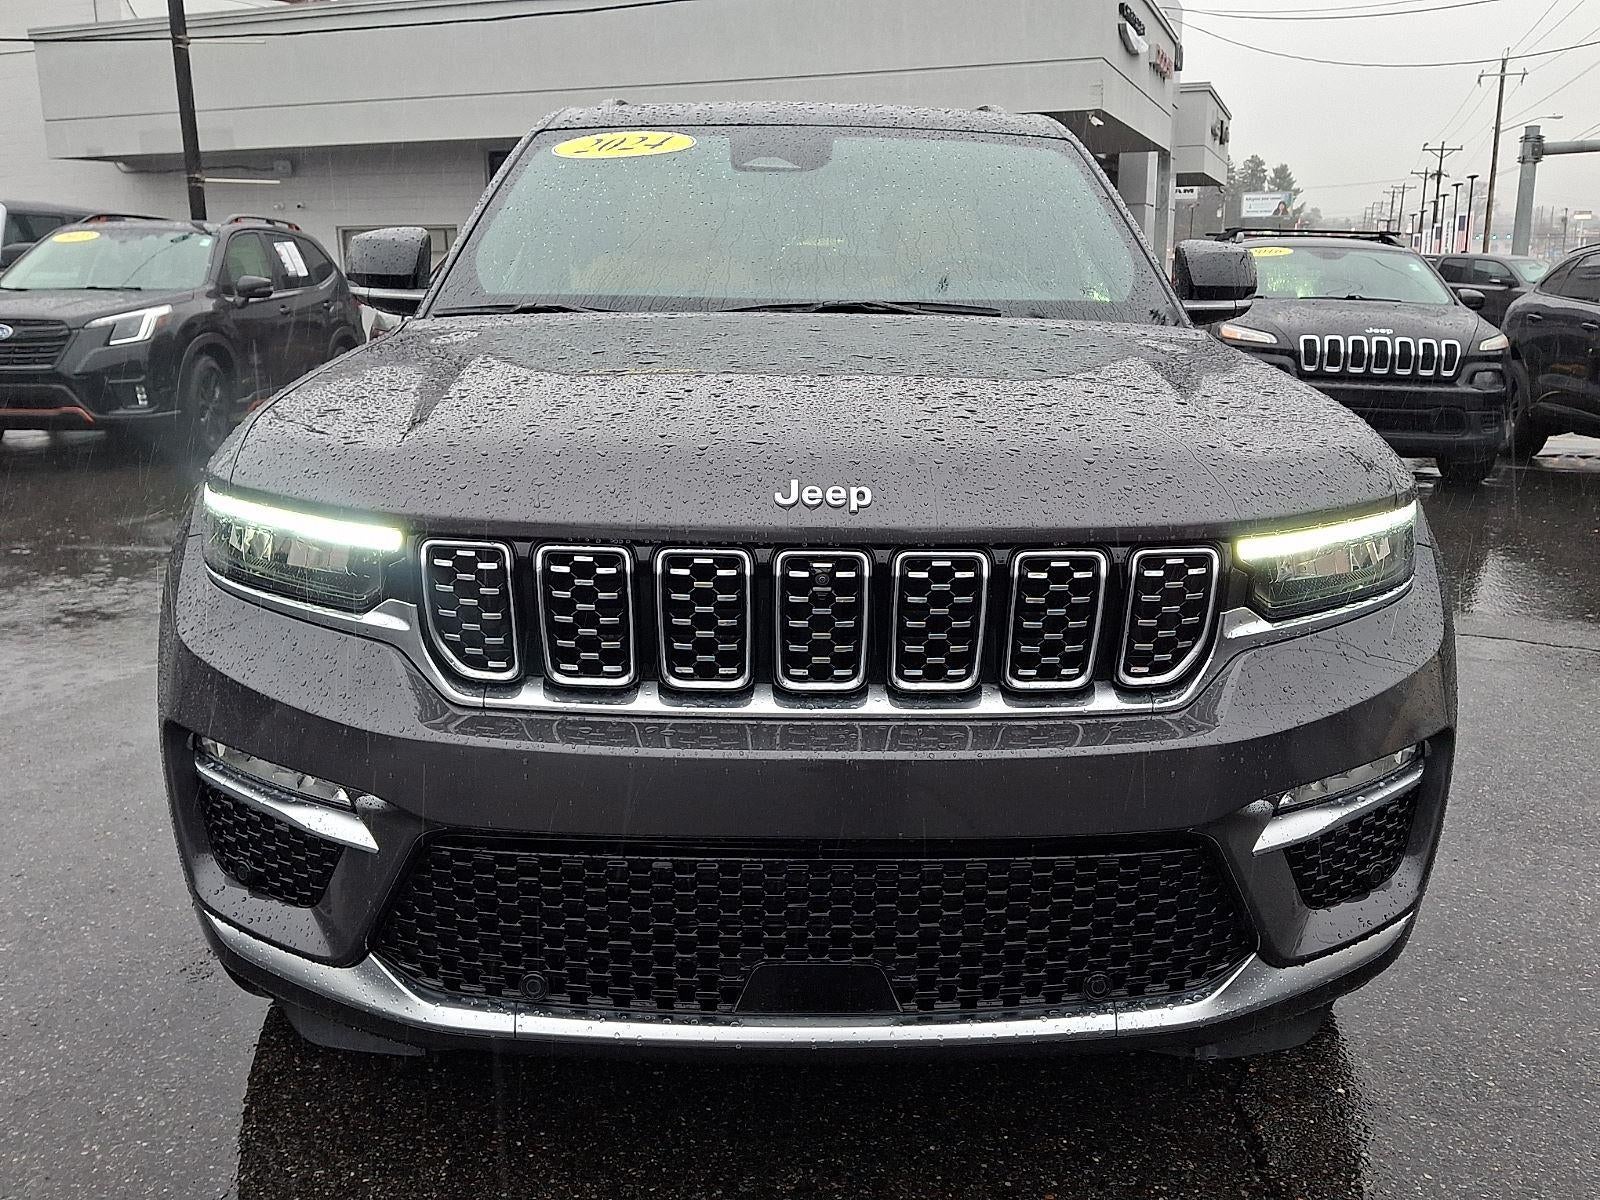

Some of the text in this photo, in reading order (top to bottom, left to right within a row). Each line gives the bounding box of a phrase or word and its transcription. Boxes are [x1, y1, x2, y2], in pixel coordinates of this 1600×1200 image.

[572, 135, 674, 154] 2024
[1365, 327, 1394, 335] Jeep
[774, 479, 872, 514] Jeep
